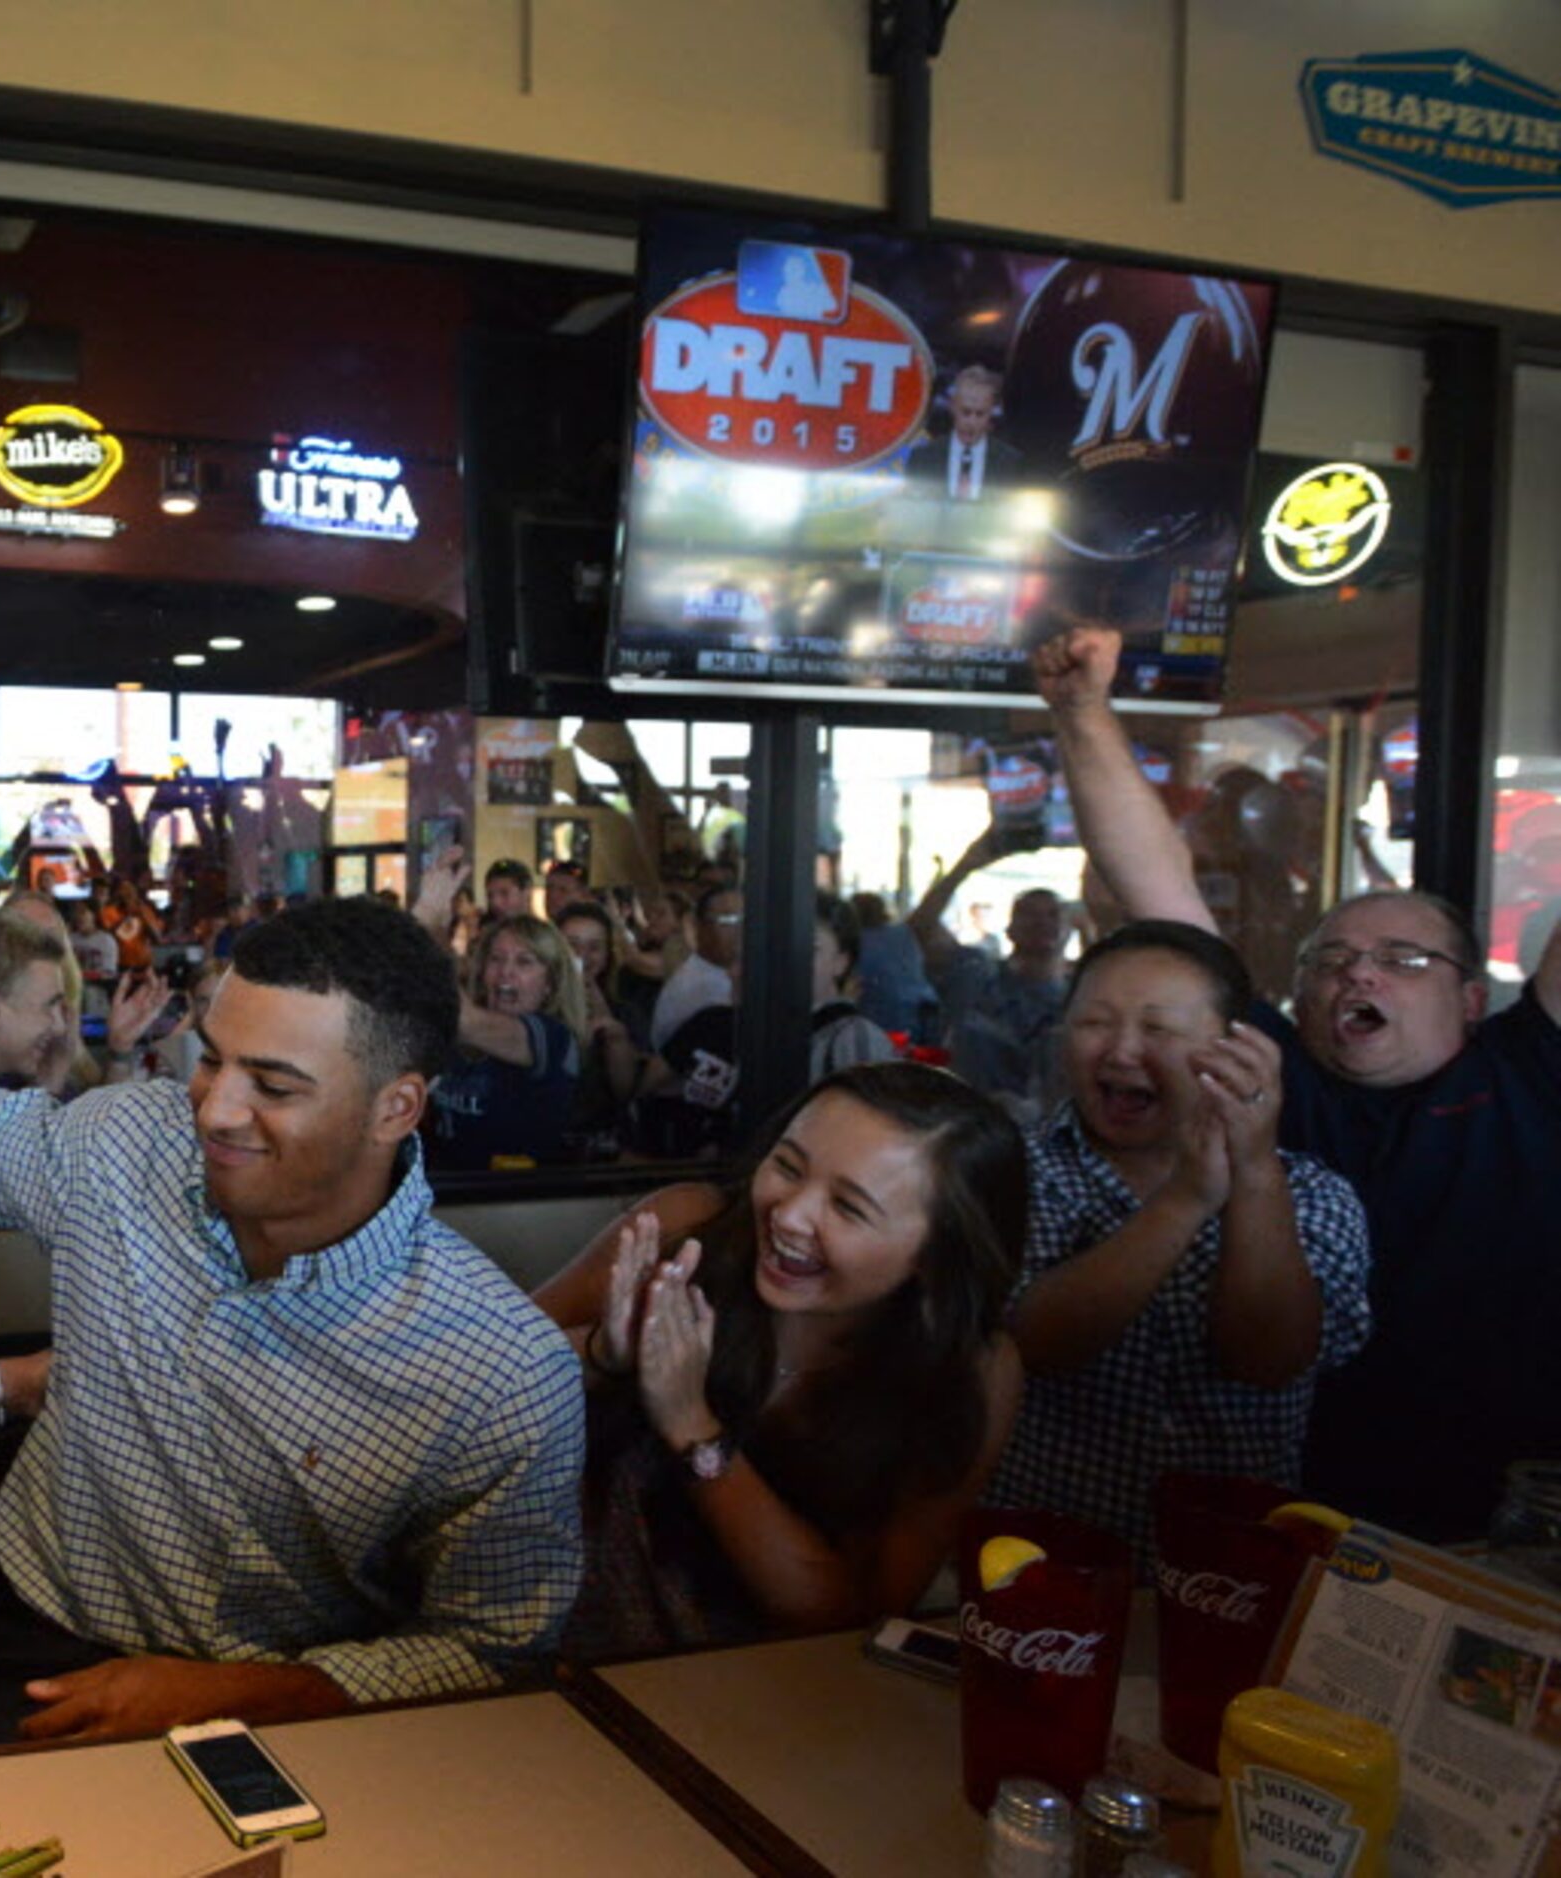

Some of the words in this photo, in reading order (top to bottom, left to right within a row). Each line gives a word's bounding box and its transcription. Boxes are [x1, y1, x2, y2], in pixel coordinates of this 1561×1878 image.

[1357, 126, 1438, 156] CRAFT
[650, 315, 914, 414] DRAFT
[6, 430, 105, 468] mike's
[258, 469, 419, 528] ULTRA
[906, 600, 989, 630] DRAFT
[959, 1602, 1106, 1678] Coca-Cola
[1264, 1781, 1328, 1817] HEINZ
[1250, 1820, 1337, 1867] MUSTARD
[1258, 1808, 1333, 1847] YELLOW
